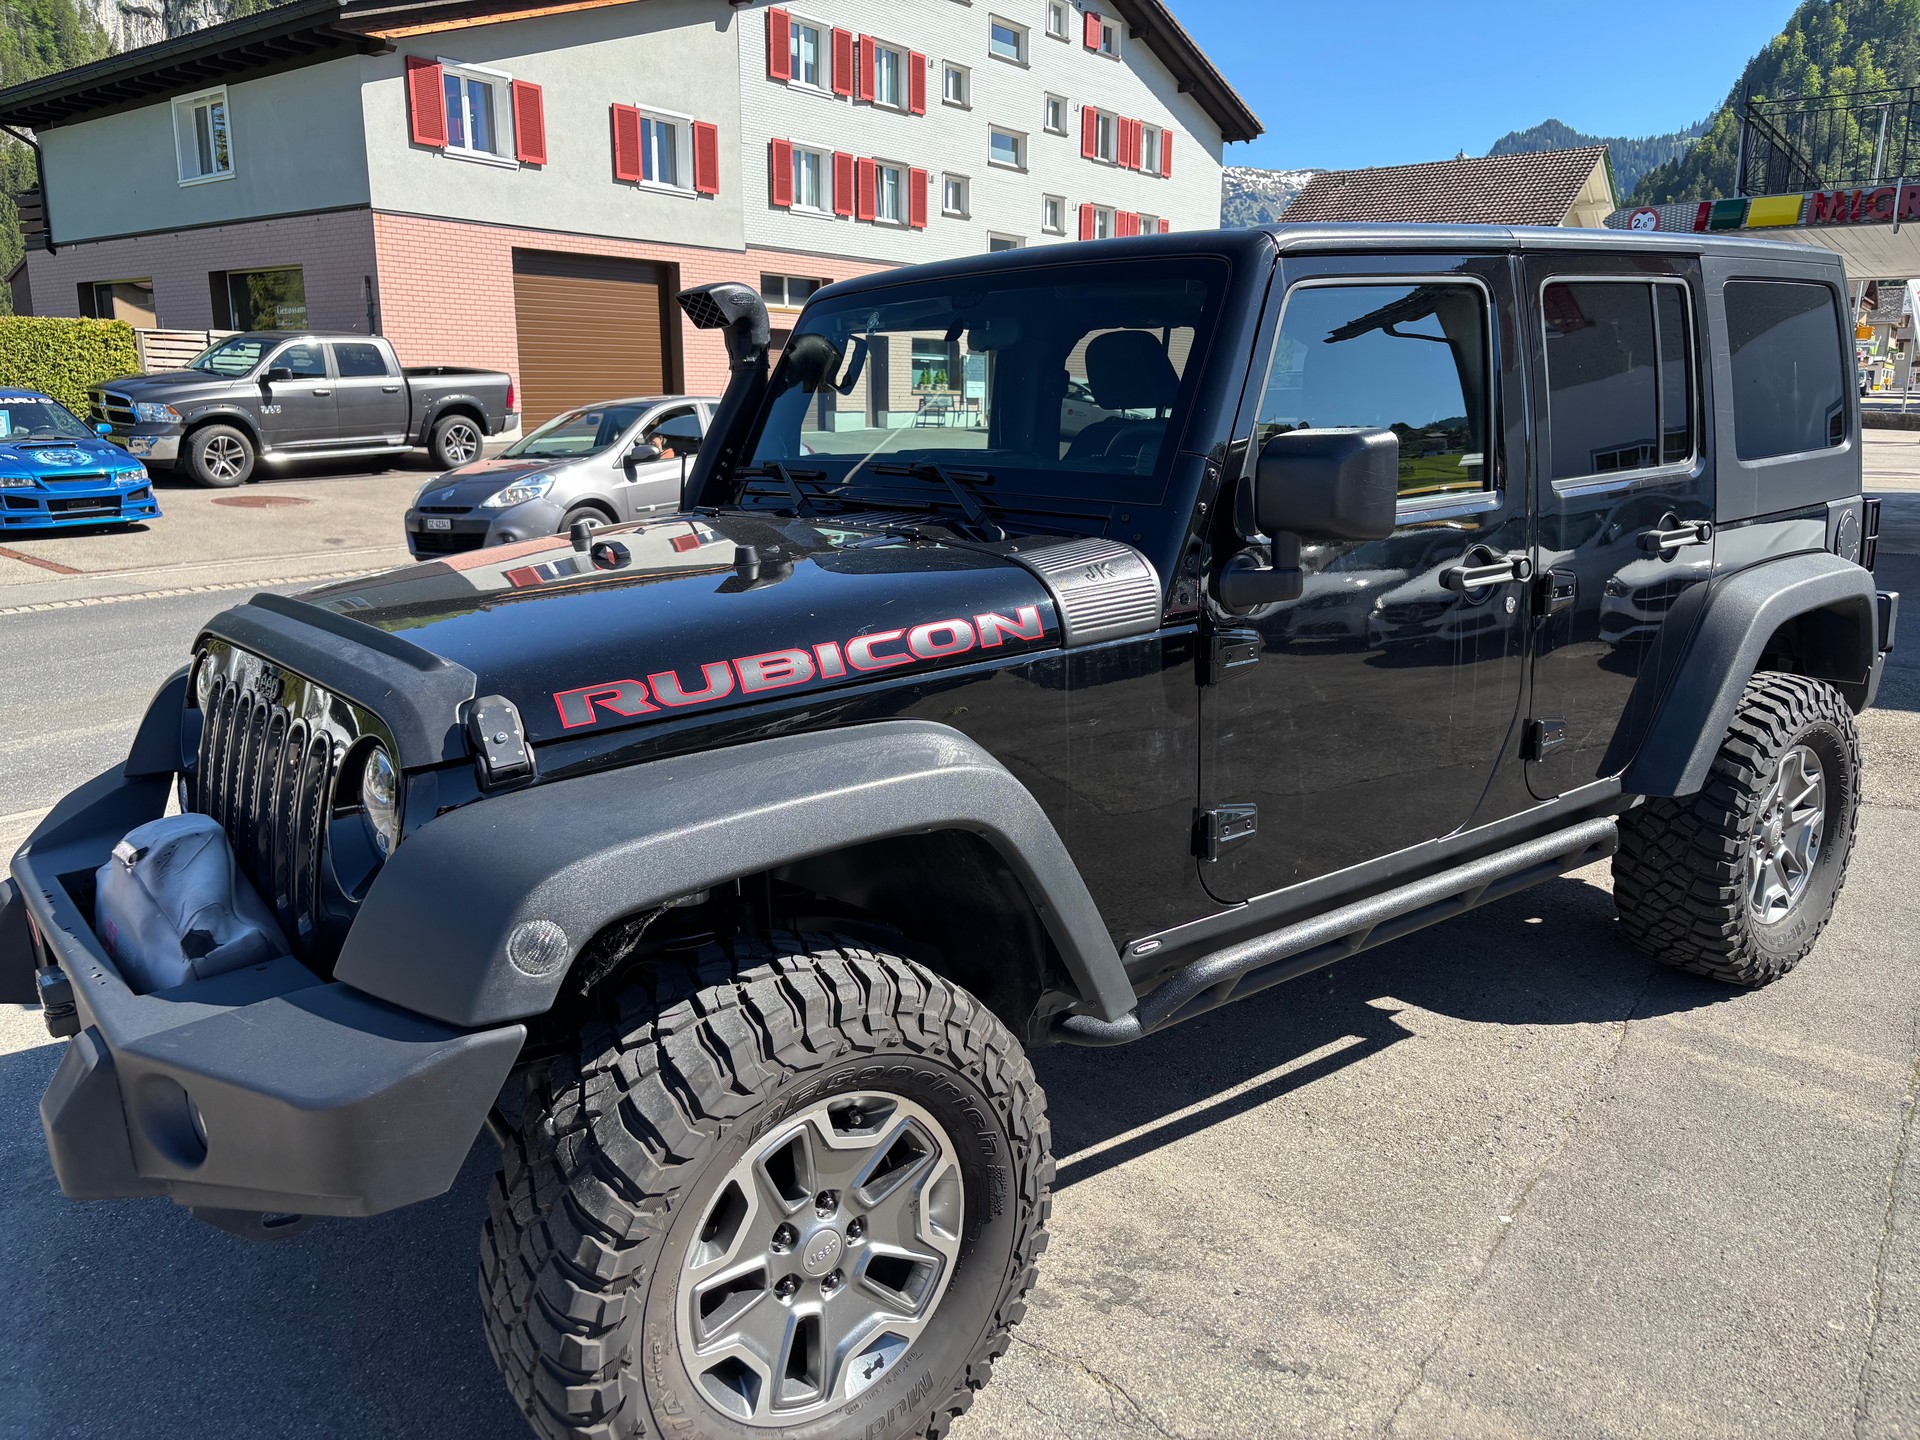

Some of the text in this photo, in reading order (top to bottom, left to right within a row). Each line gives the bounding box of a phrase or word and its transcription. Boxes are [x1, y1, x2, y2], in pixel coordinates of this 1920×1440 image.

[1085, 561, 1116, 582] JK
[553, 604, 1045, 730] RUBICON
[748, 1064, 998, 1157] BFGoodrich
[808, 1239, 837, 1267] Jeep
